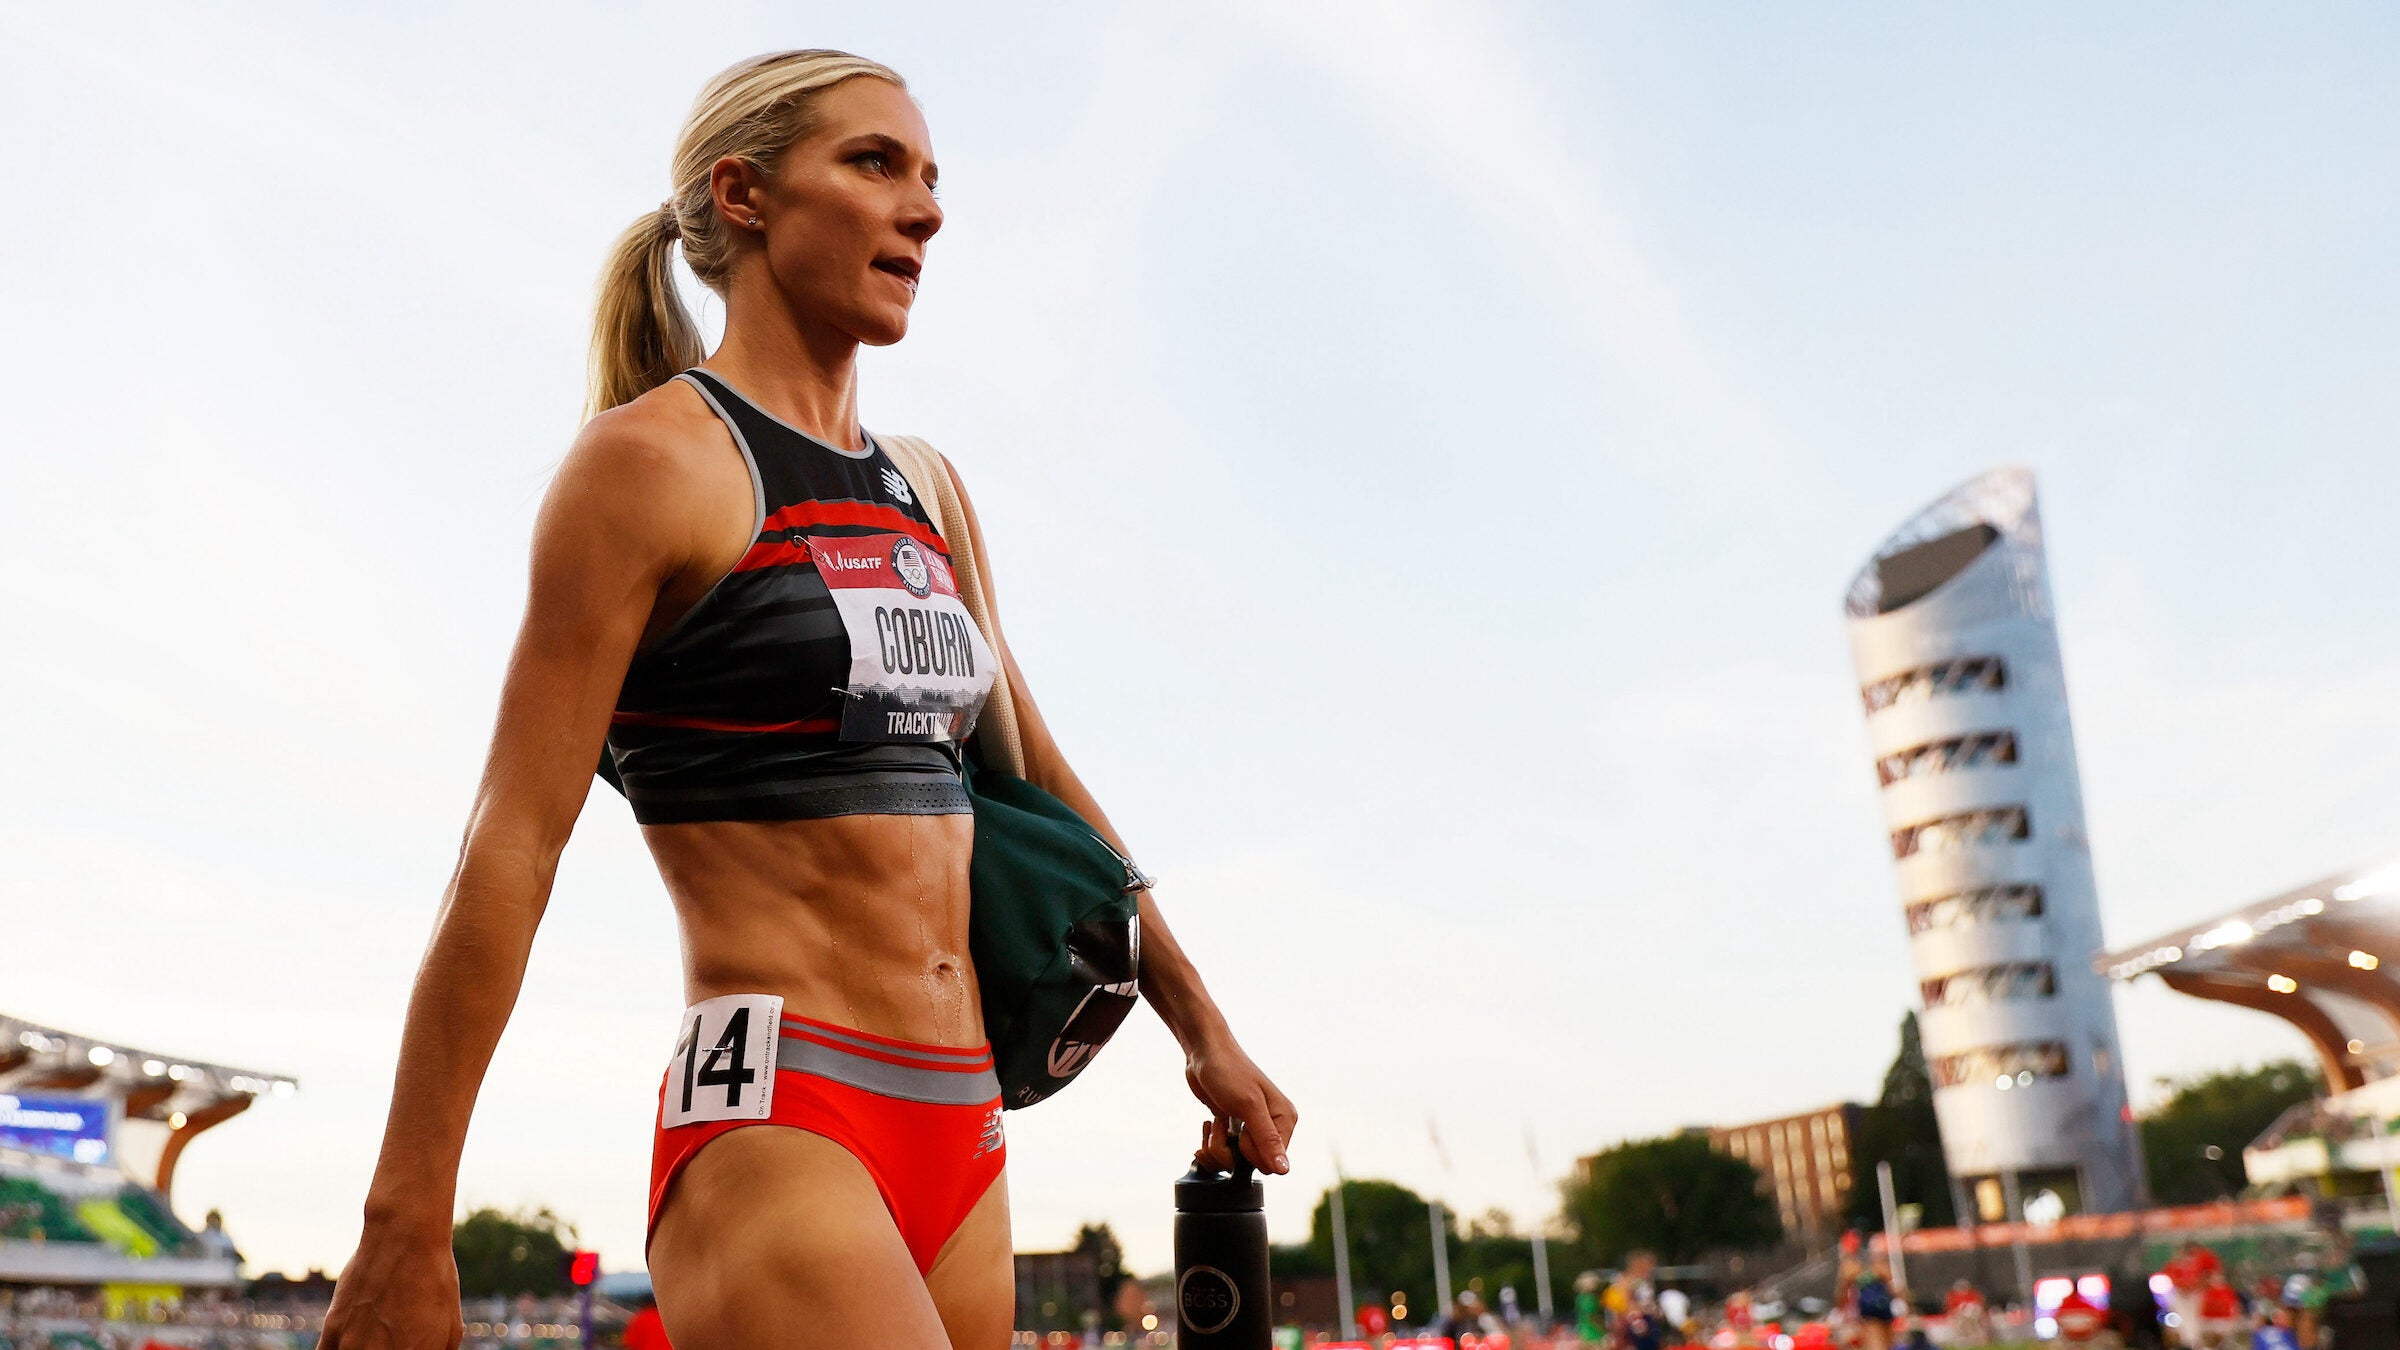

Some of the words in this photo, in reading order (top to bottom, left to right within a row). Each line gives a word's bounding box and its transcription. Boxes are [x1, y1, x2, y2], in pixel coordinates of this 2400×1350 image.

[843, 557, 882, 570] USATF
[875, 606, 975, 678] COBURN
[677, 1007, 756, 1113] 14
[1184, 1292, 1228, 1309] BOSS
